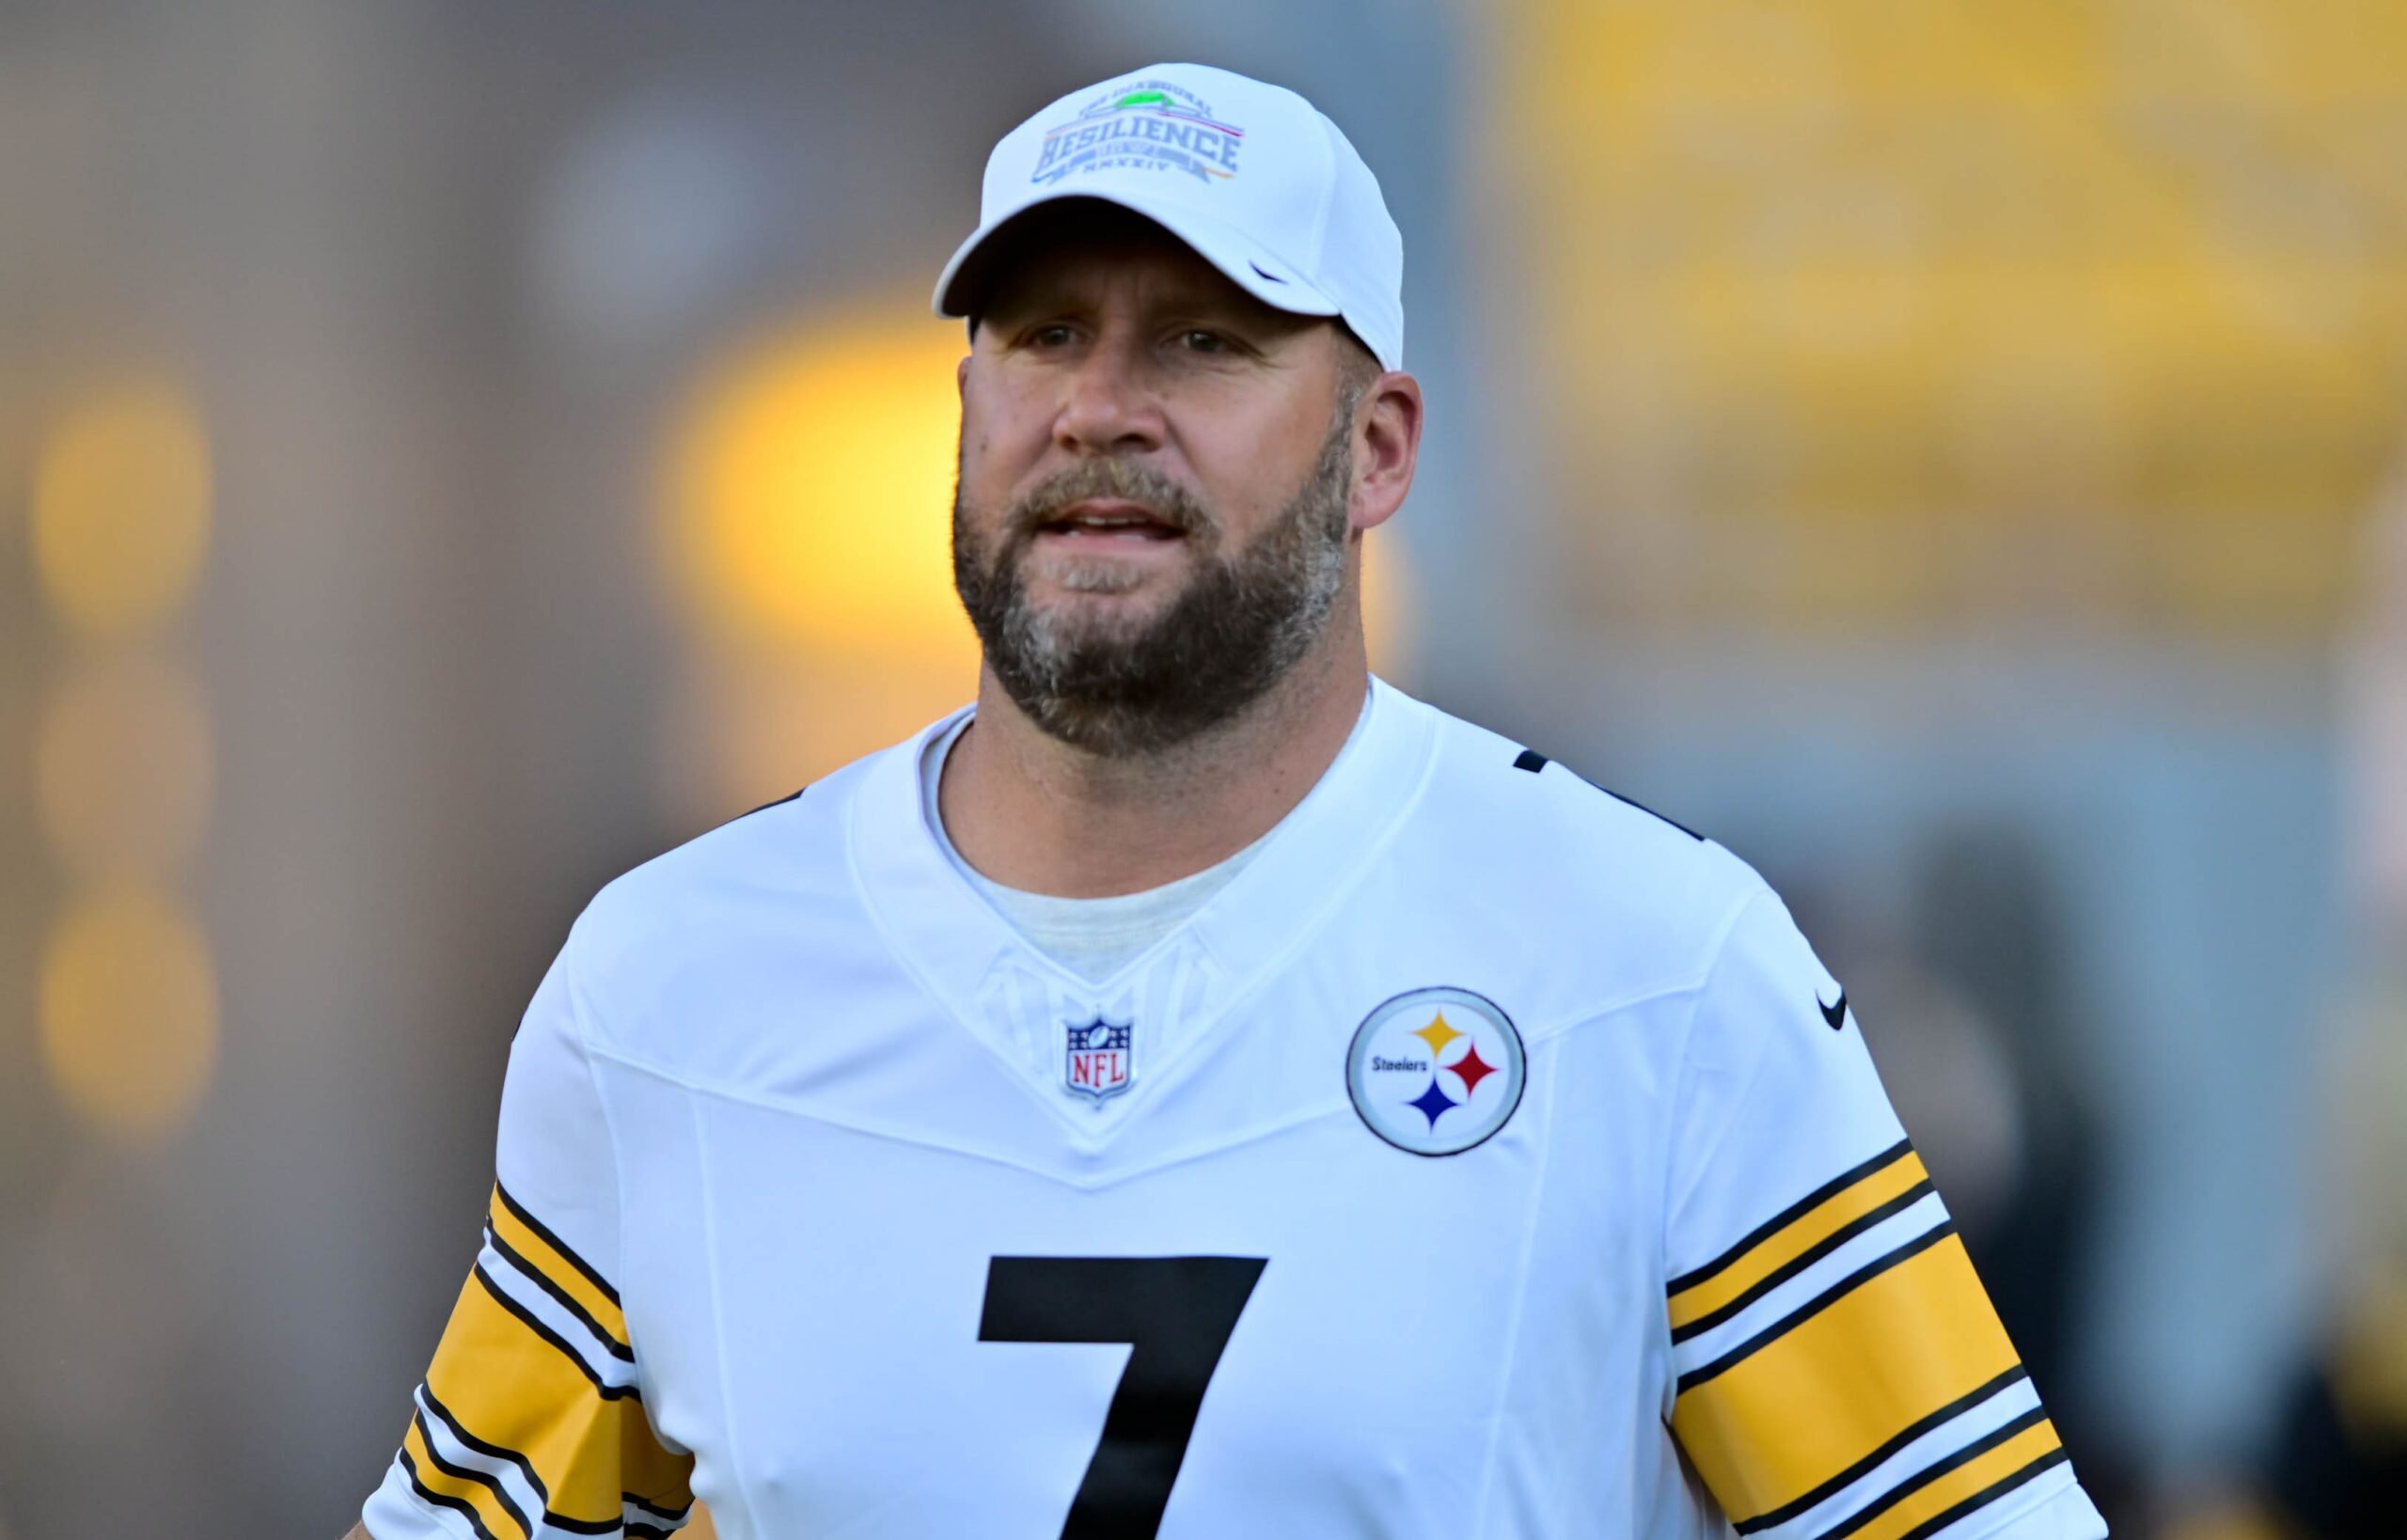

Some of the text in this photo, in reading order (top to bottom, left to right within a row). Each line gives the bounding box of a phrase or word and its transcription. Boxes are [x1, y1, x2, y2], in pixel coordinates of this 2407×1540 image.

[1036, 115, 1243, 173] RESILIENCE
[1073, 1052, 1125, 1089] NFL
[1371, 1055, 1428, 1073] Steelers
[977, 1255, 1269, 1540] 7
